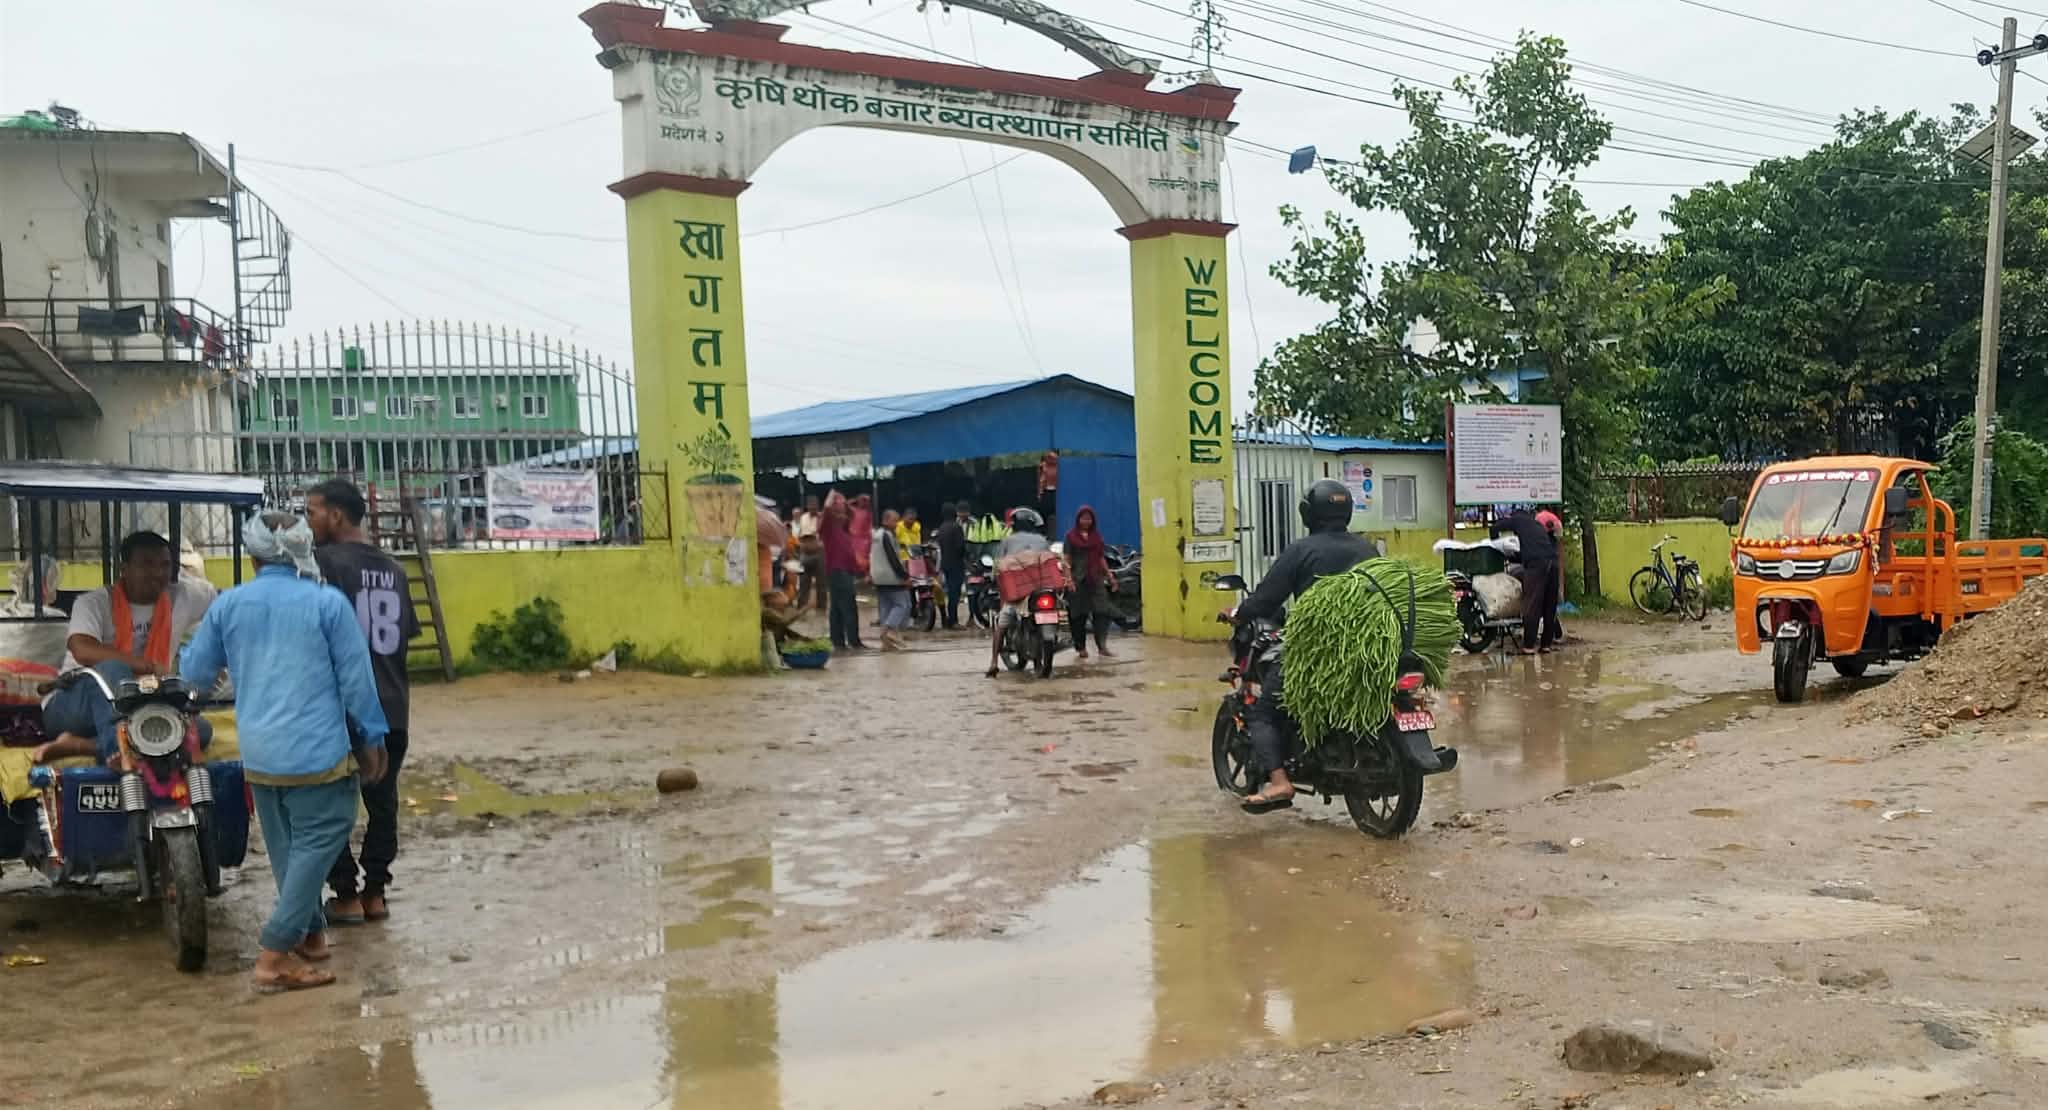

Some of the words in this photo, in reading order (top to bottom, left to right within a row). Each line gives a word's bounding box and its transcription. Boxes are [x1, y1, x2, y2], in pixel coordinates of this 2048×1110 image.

[713, 76, 787, 110] कृषि
[792, 83, 858, 114] थोक
[864, 96, 936, 124] बजार
[1087, 121, 1170, 152] समिति
[1183, 256, 1222, 465] WELCOME
